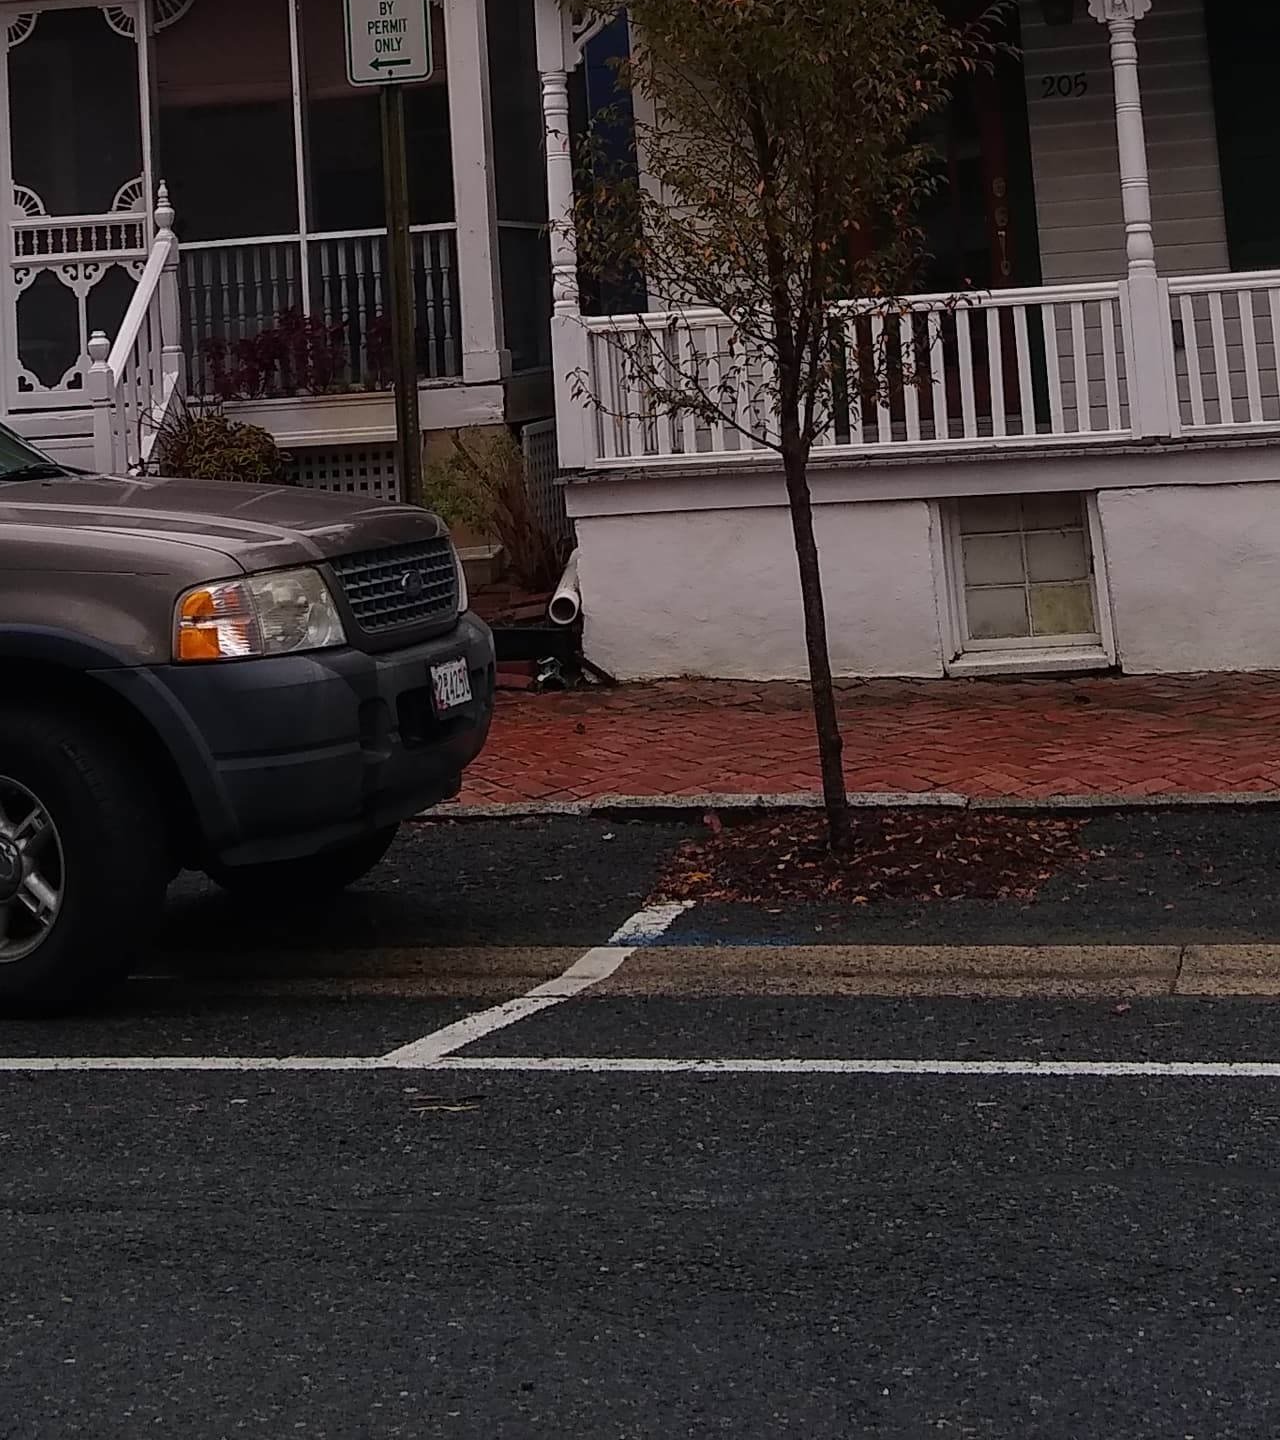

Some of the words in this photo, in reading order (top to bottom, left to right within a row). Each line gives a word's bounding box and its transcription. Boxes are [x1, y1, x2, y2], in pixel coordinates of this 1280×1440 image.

[379, 1, 394, 16] BY
[367, 18, 408, 35] PERMIT
[374, 37, 403, 53] ONLY
[1041, 71, 1088, 99] 205
